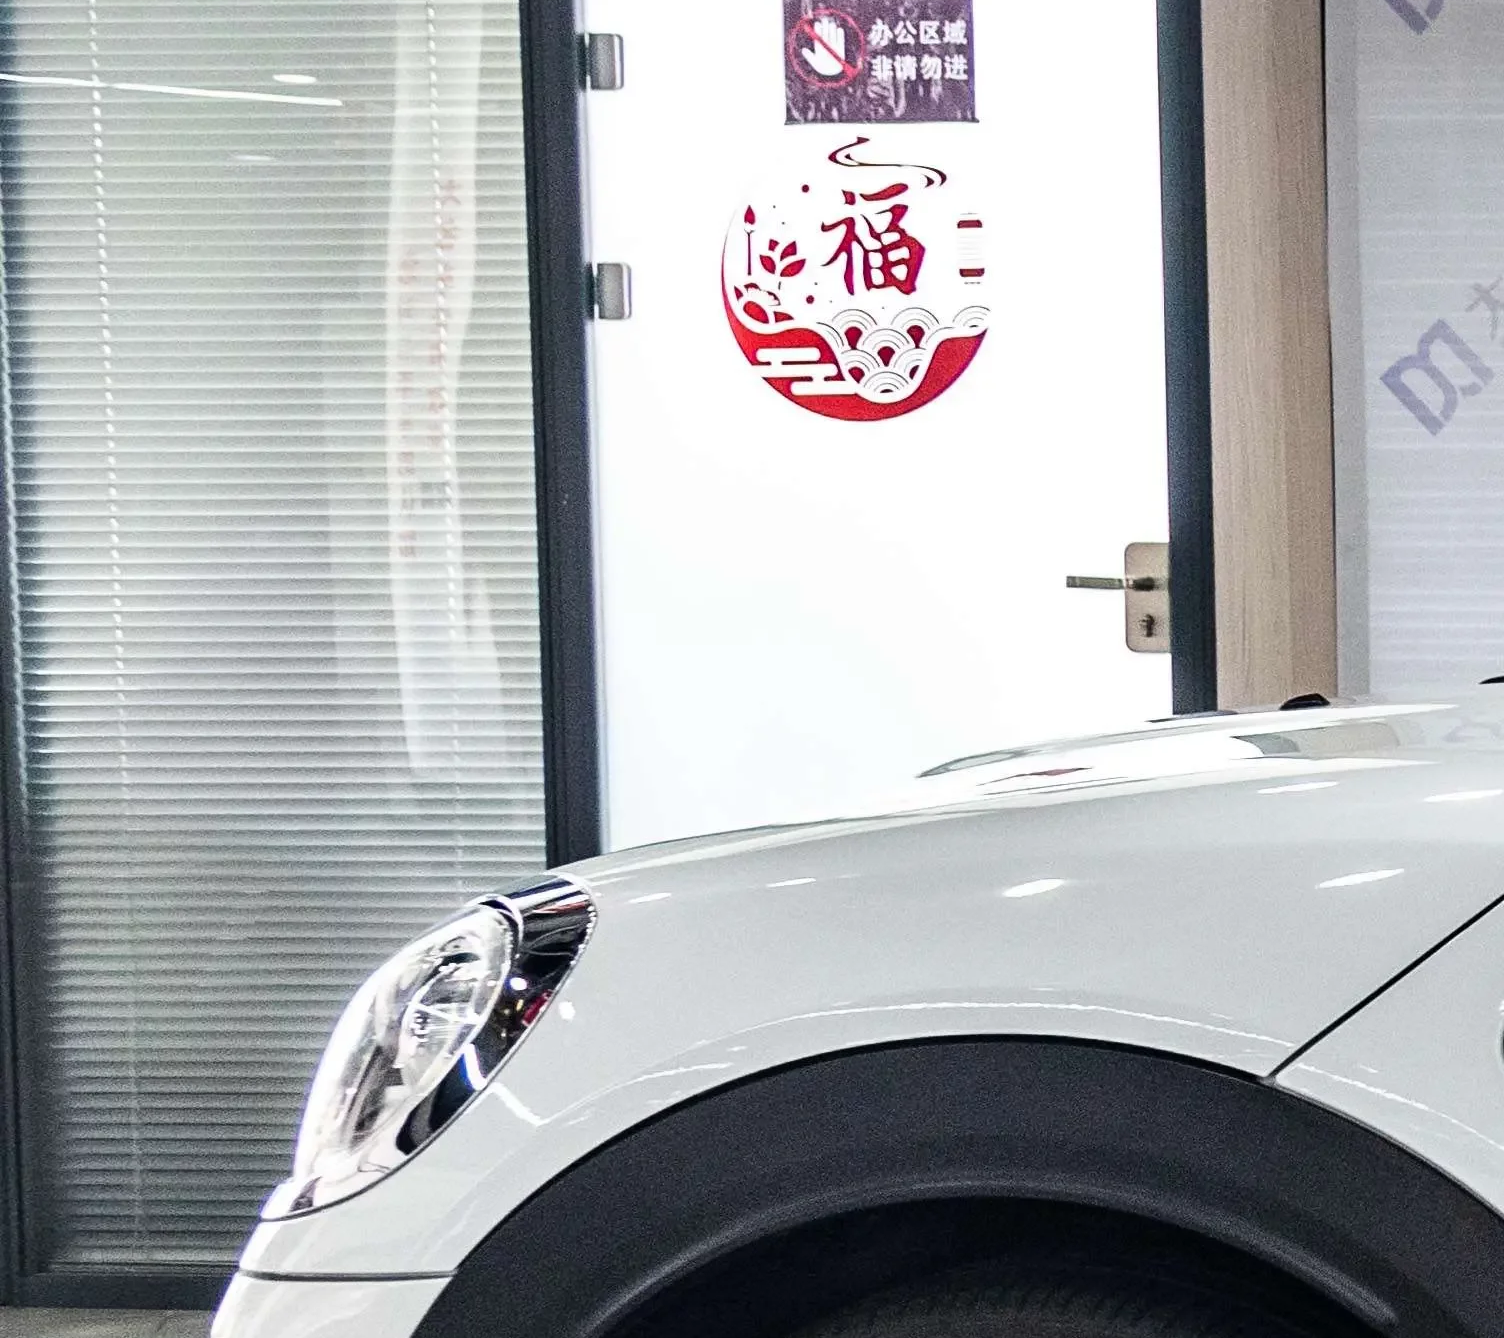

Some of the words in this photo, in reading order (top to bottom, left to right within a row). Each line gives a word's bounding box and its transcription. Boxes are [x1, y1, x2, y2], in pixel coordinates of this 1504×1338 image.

[867, 18, 968, 46] 办公区域
[871, 54, 968, 81] 非请勿进
[820, 181, 926, 297] 福
